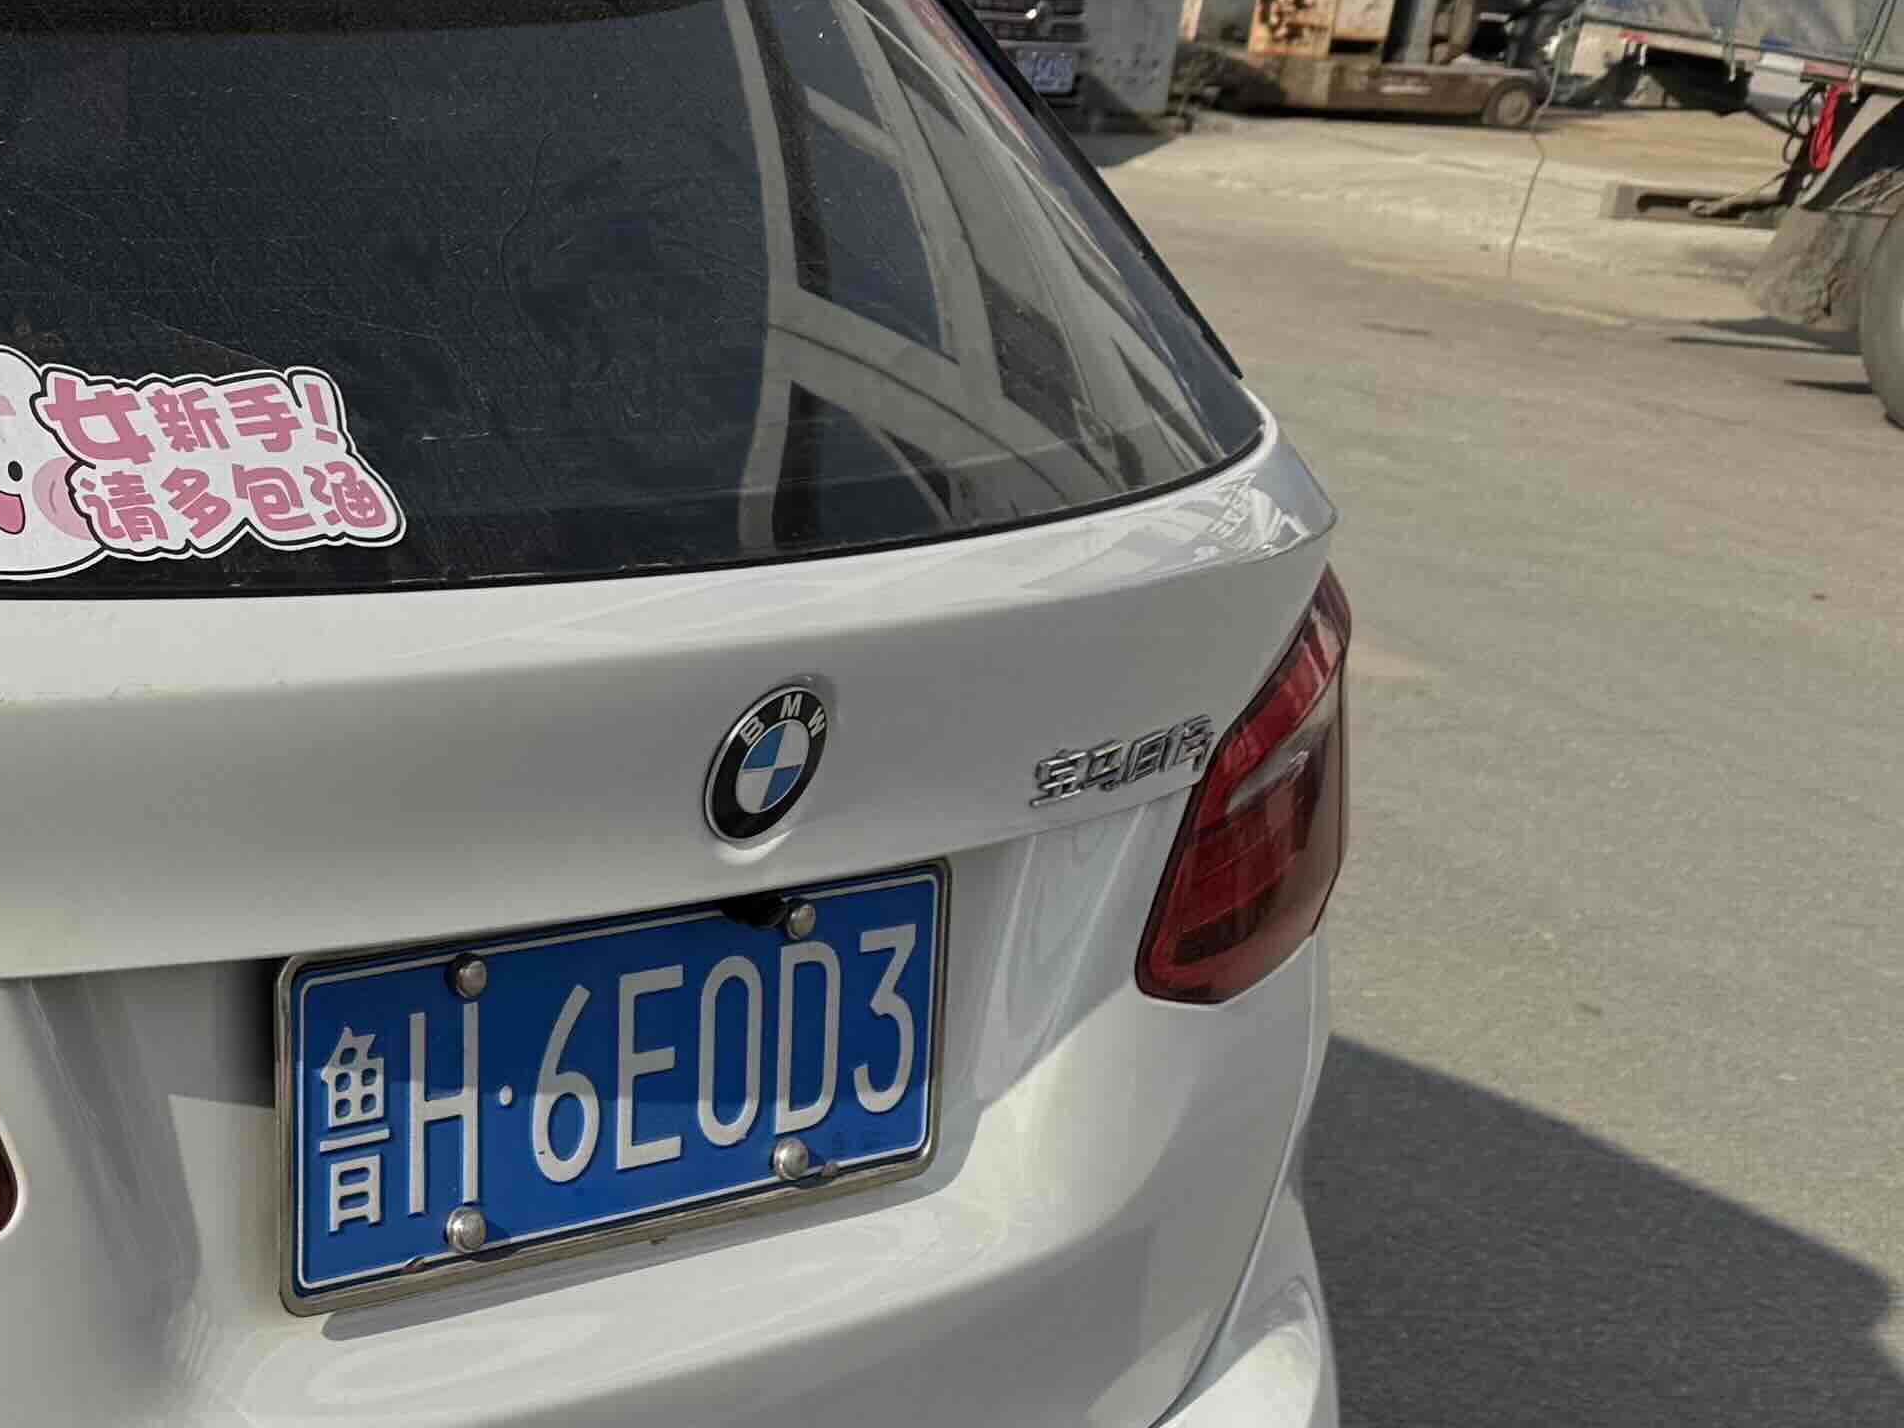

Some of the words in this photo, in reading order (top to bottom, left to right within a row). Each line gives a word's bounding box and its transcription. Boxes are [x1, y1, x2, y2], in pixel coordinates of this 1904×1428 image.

[78, 460, 387, 542] 请多包涵
[739, 693, 825, 747] BMW
